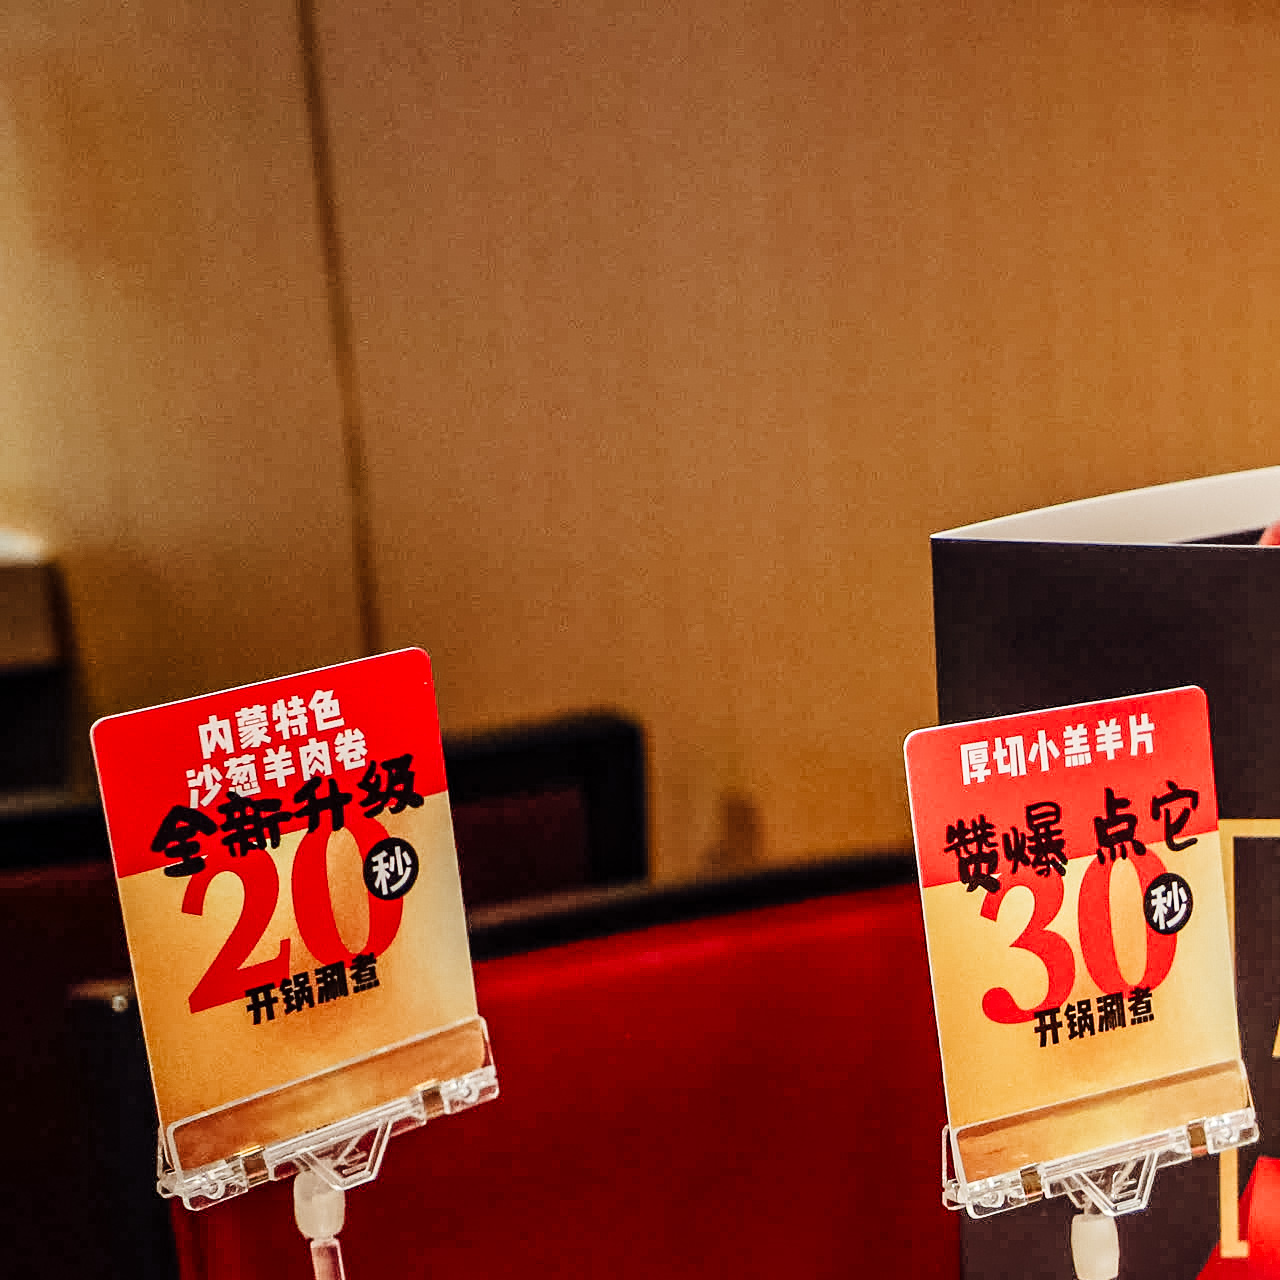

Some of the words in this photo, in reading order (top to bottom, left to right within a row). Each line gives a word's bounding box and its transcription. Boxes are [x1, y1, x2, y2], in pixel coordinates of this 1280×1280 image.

[197, 689, 346, 760] 内蒙特色
[960, 712, 1156, 785] 厚切小羔羊片
[186, 728, 369, 809] 沙葱羊肉卷
[151, 753, 425, 878] 全新升级
[1093, 780, 1199, 862] 点它
[246, 952, 381, 1026] 开锅涮煮
[1033, 986, 1155, 1048] 开锅涮煮
